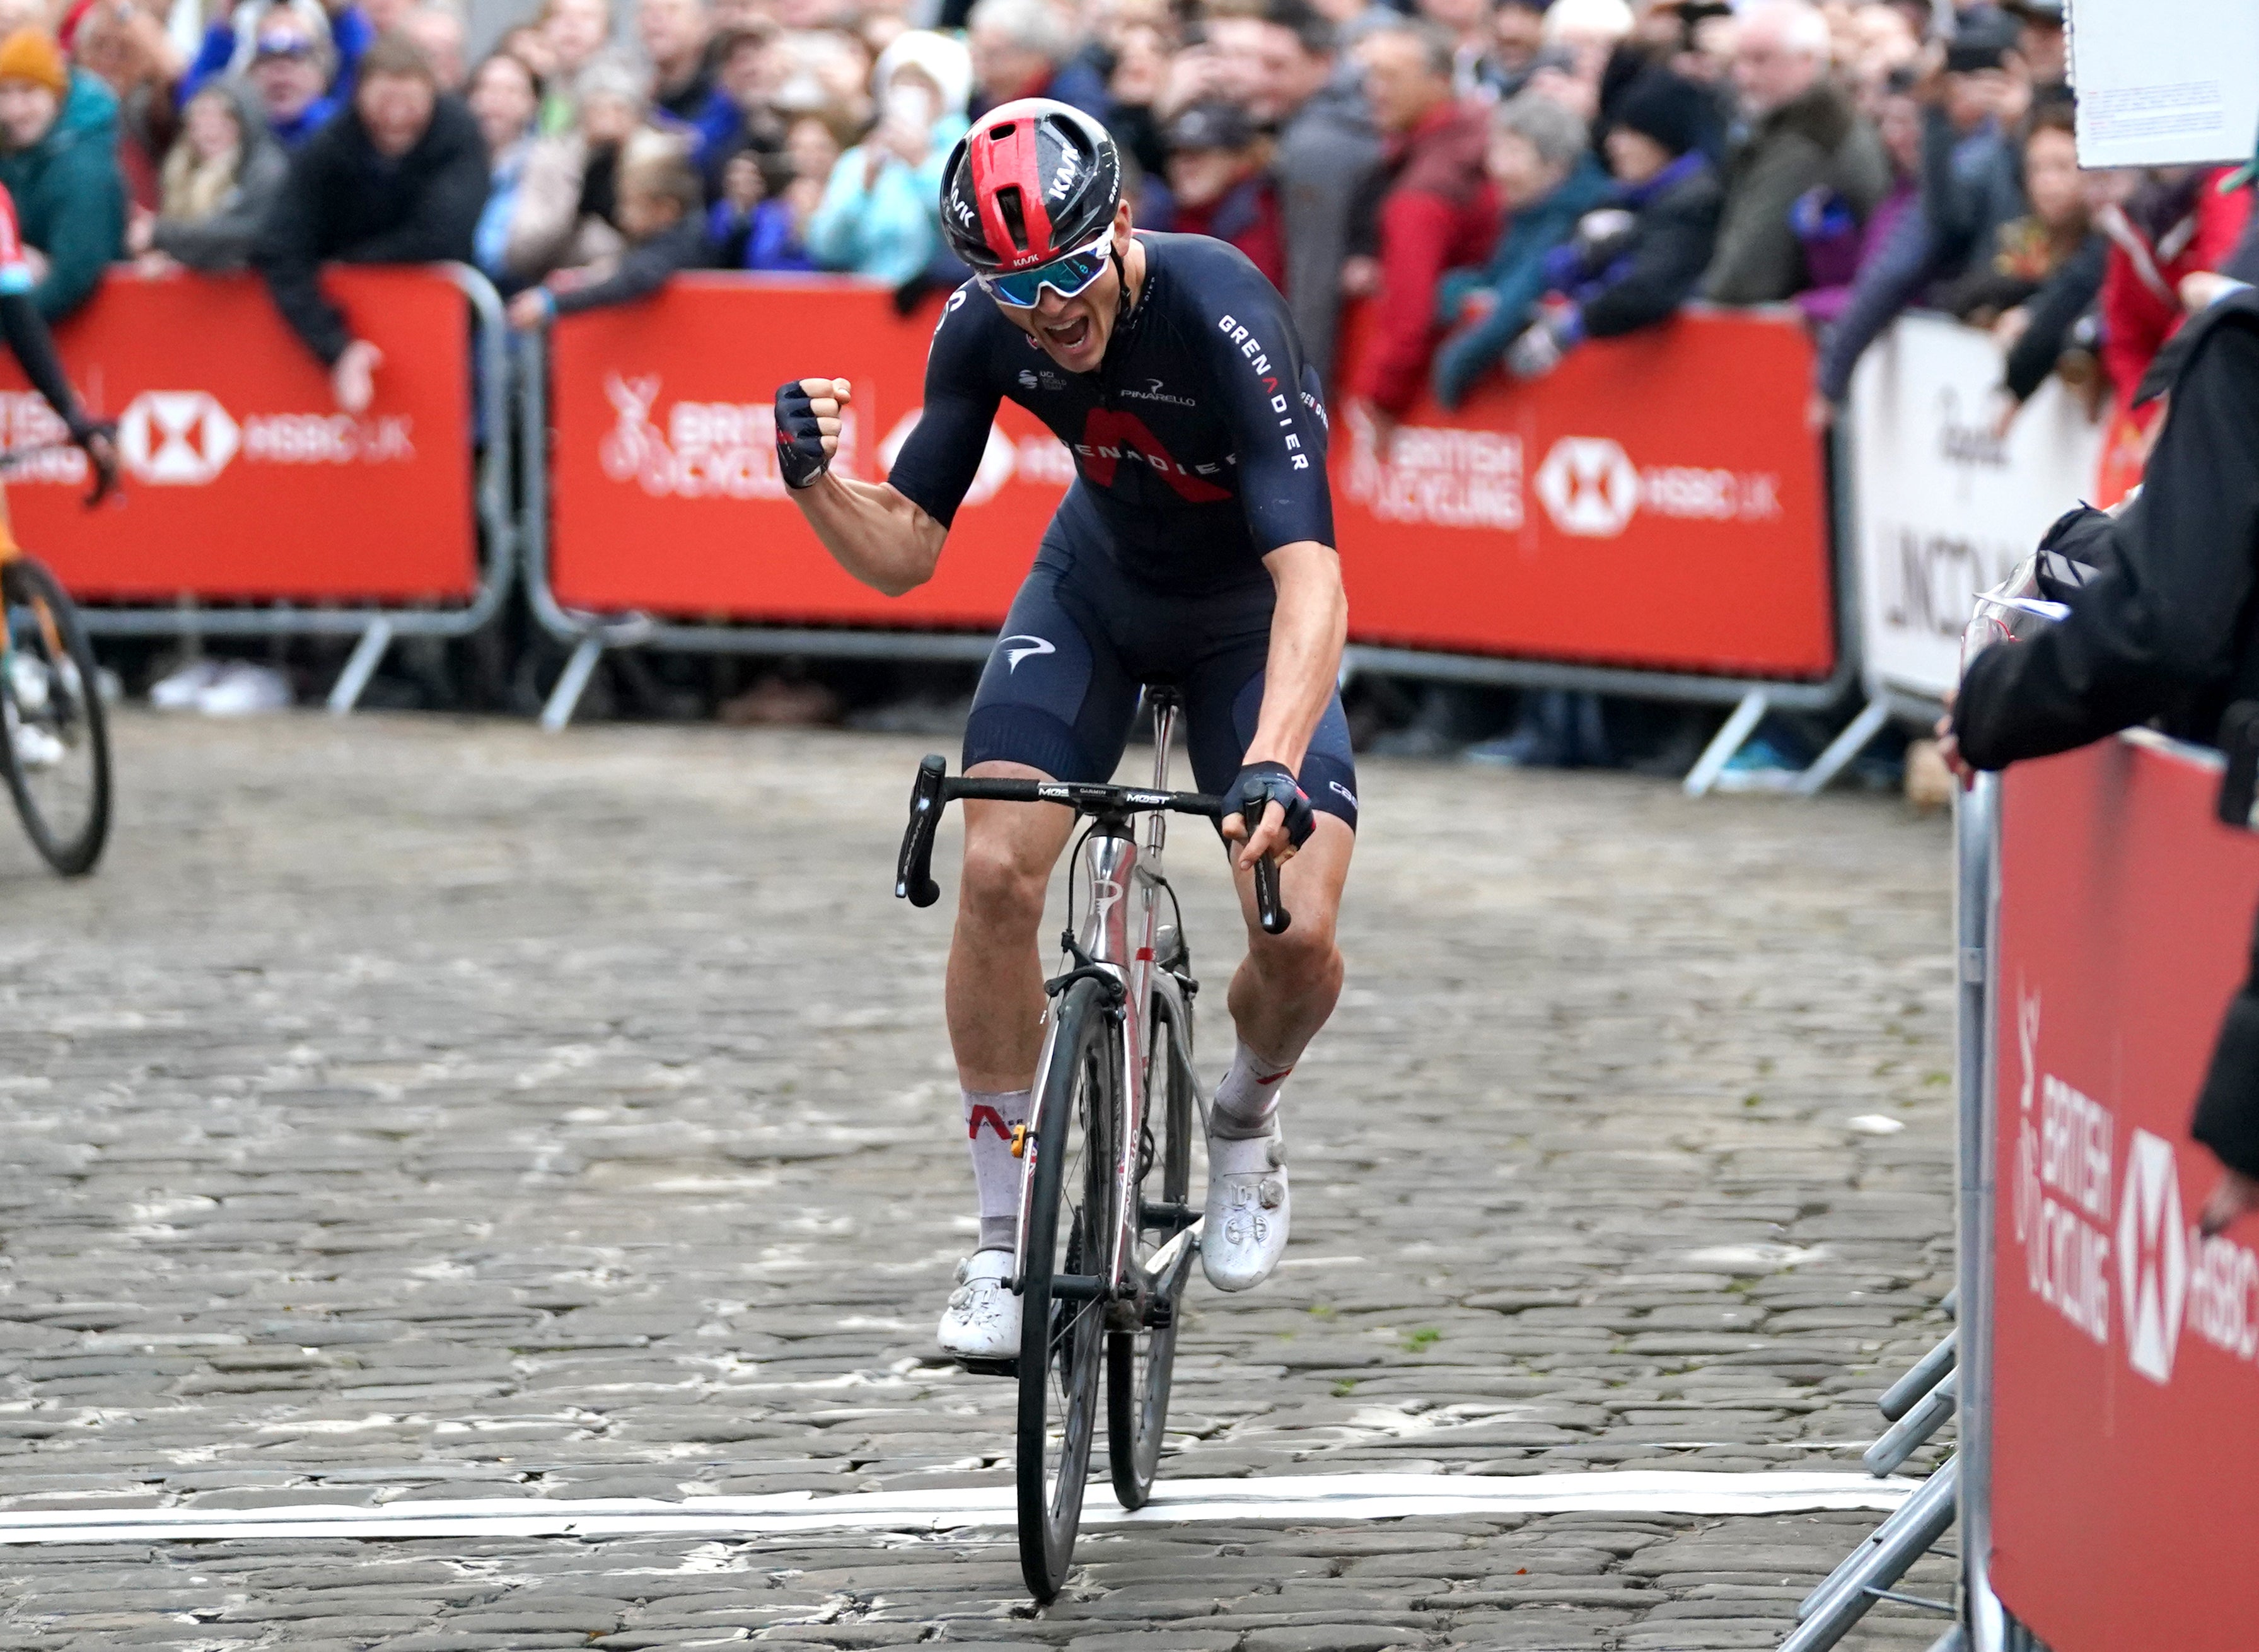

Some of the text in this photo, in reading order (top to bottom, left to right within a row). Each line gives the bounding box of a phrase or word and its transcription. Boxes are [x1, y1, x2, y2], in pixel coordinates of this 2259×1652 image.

[1048, 142, 1078, 201] KASK
[1013, 253, 1039, 267] KASK
[1121, 390, 1196, 407] PINARELLO
[1218, 314, 1309, 470] GRENADIER
[1641, 465, 1737, 520] HSBC
[1038, 788, 1069, 798] MØS
[2042, 1073, 2113, 1223] BRITISH
[2041, 1197, 2110, 1345] CYCLING
